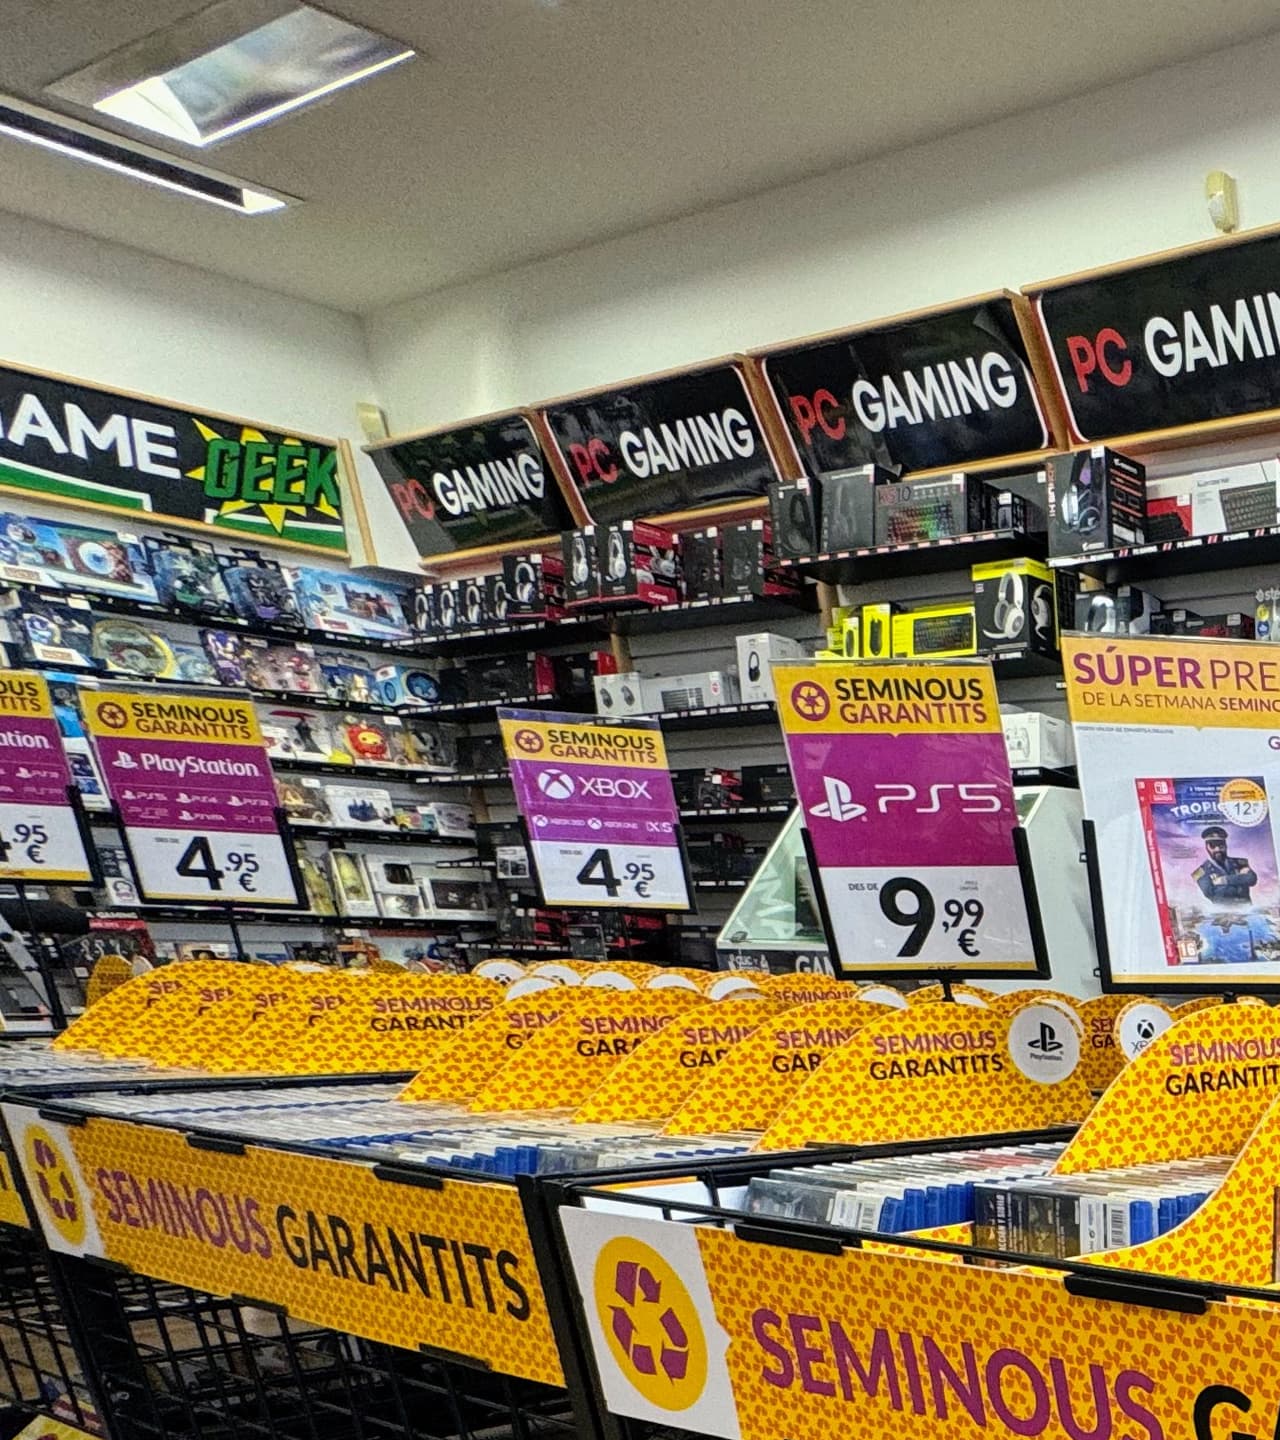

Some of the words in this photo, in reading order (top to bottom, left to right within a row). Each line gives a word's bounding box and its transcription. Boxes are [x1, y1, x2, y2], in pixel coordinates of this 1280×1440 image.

[1067, 328, 1132, 392] PC
[791, 388, 847, 445] PC
[854, 350, 1018, 432] GAMING
[0, 394, 181, 480] AME
[572, 438, 620, 484] PC
[619, 408, 755, 477] GAMING
[205, 438, 341, 504] GEEK
[389, 478, 436, 522] PC
[432, 453, 547, 516] GAMING
[1073, 646, 1204, 690] SÚPER
[834, 678, 984, 702] SEMINOUS
[1083, 691, 1105, 706] DE
[1111, 692, 1131, 707] LA
[1135, 693, 1216, 710] SETMANA
[132, 701, 248, 725] SEMINOUS
[840, 701, 987, 726] GARANTITS
[136, 718, 251, 740] GARANTITS
[547, 730, 655, 750] SEMINOUS
[142, 751, 259, 778] PlayStation
[550, 744, 657, 764] GARANTITS
[577, 776, 652, 800] XBOX
[874, 784, 1001, 813] PS5
[238, 873, 257, 893] €
[635, 881, 651, 898] €
[957, 928, 981, 957] €
[374, 996, 494, 1014] SEMINOUS
[873, 1029, 997, 1055] SEMINOUS
[869, 1054, 1004, 1081] GARANTITS
[95, 1168, 273, 1260] SEMINOUS
[276, 1203, 531, 1322] GARANTITS
